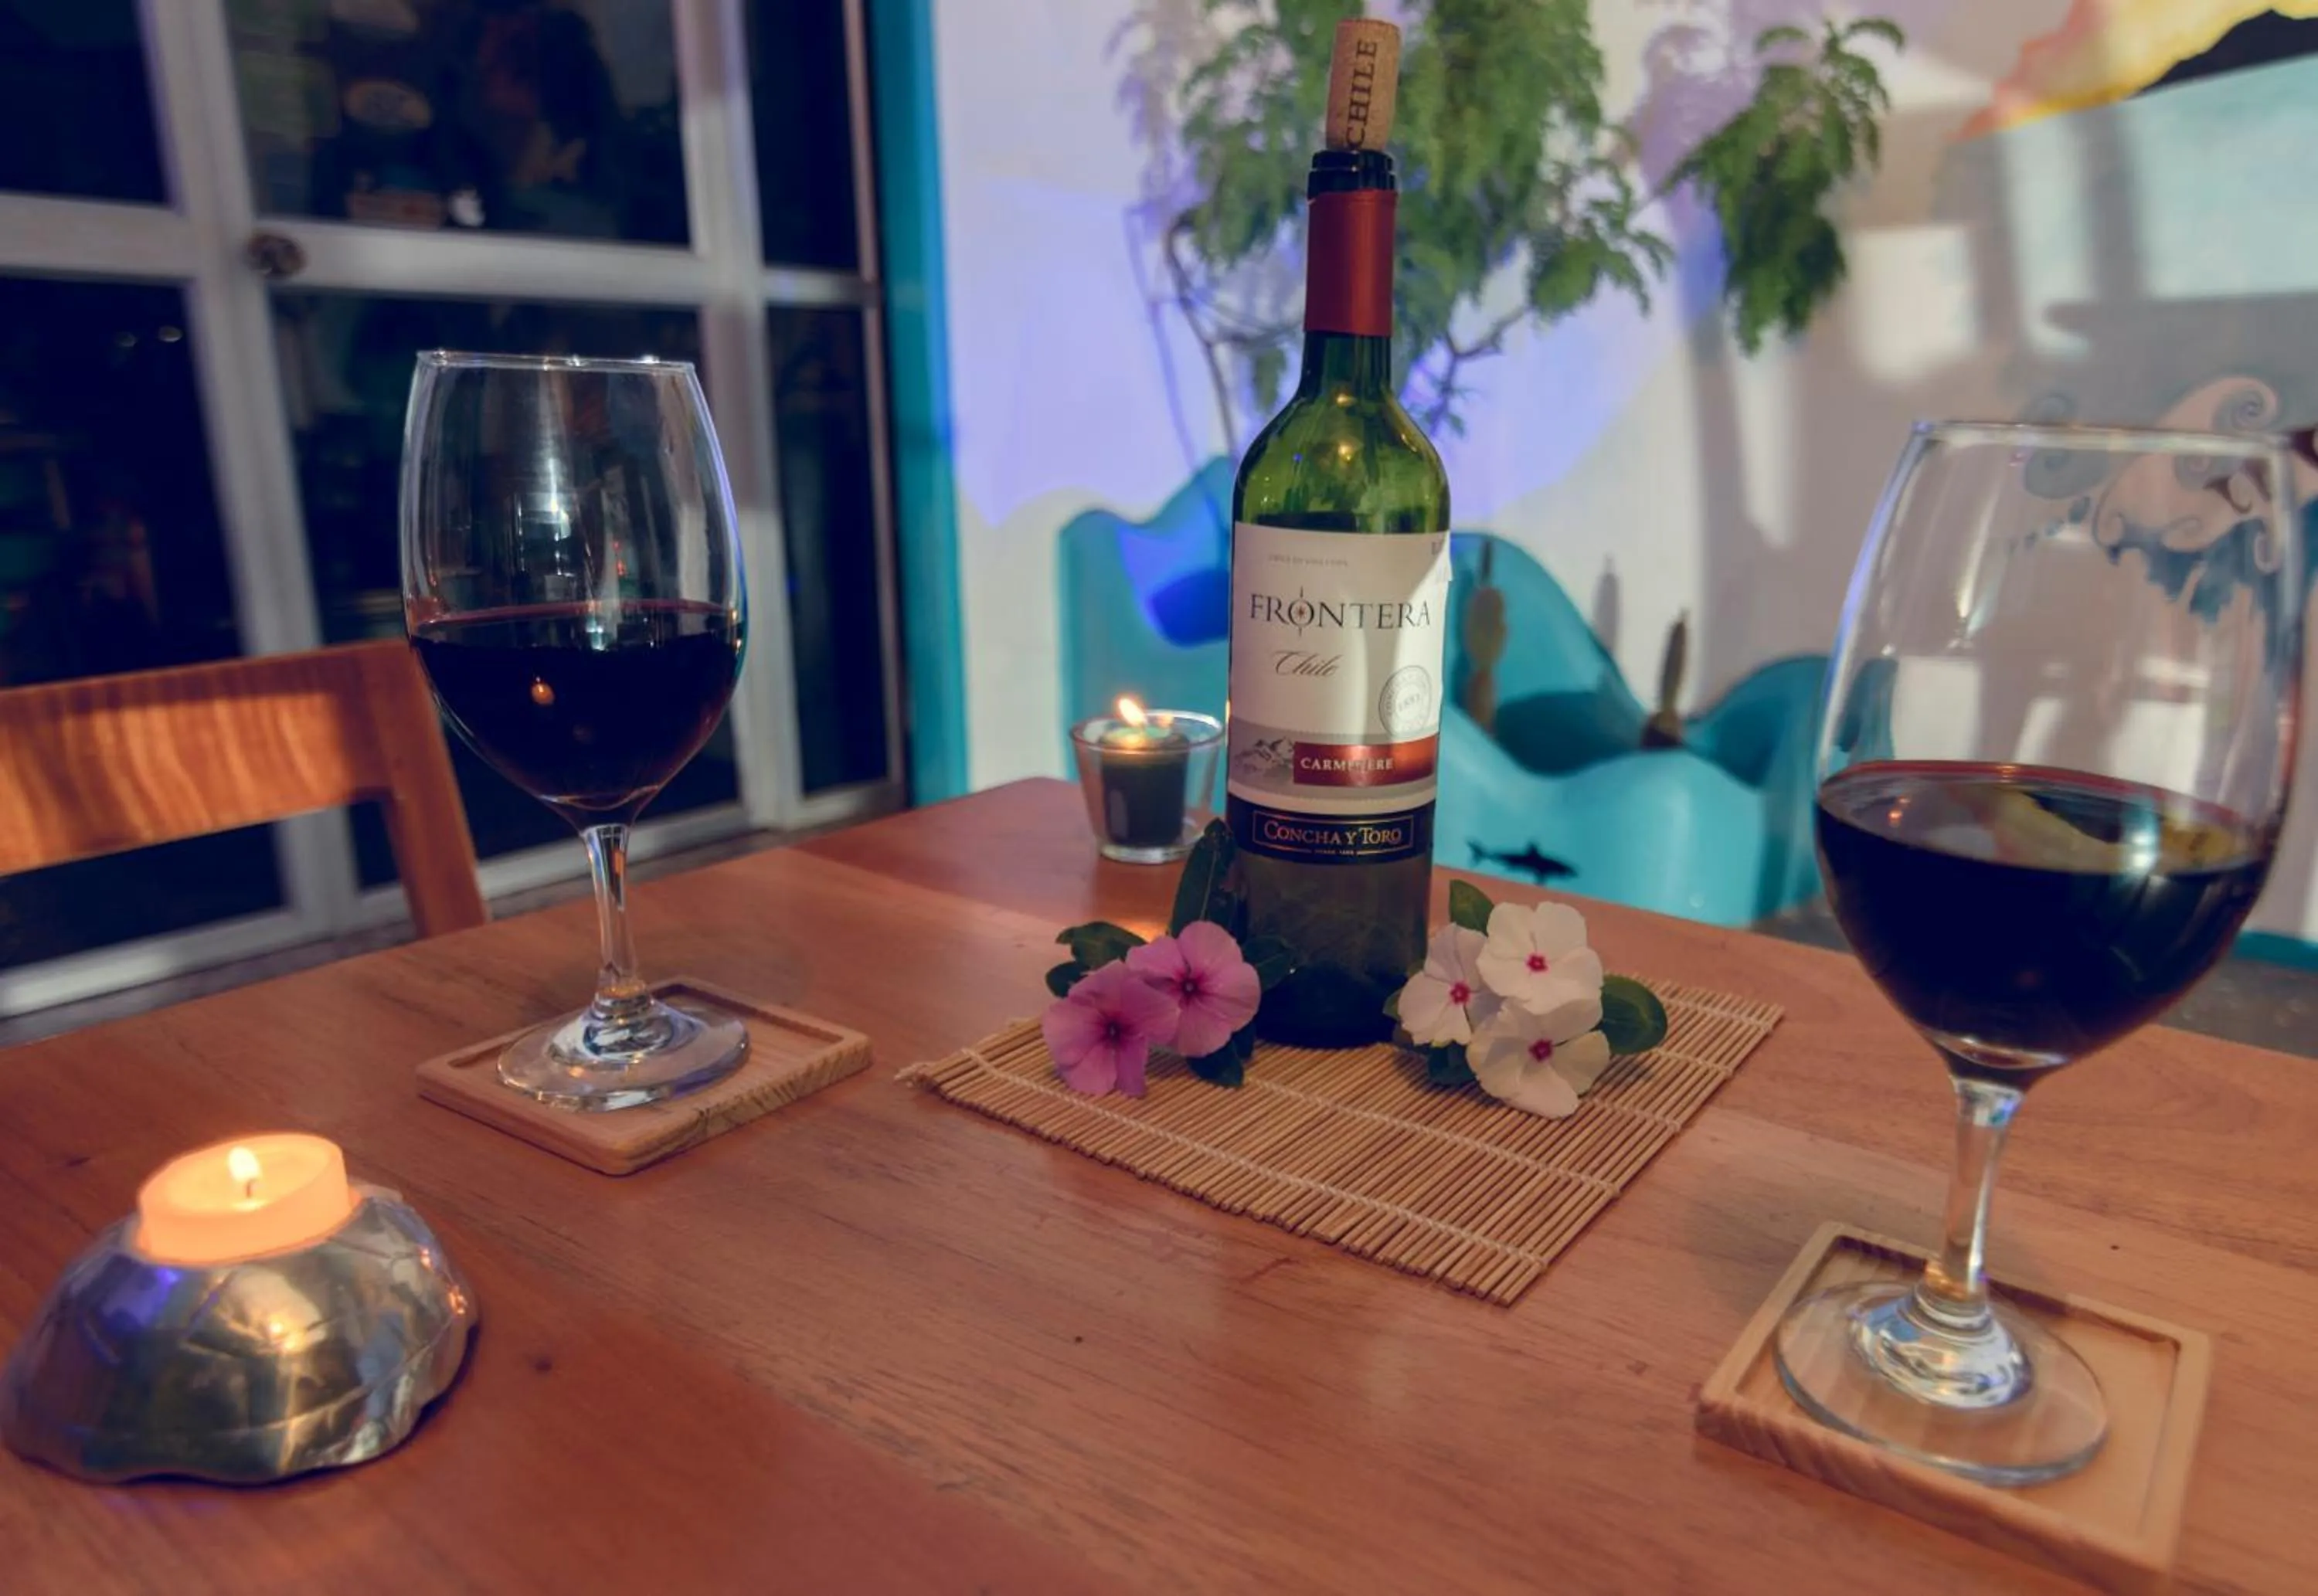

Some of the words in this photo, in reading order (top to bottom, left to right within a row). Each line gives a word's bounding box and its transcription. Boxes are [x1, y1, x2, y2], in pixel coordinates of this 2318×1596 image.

[1346, 39, 1377, 149] CHILE
[1249, 590, 1431, 632] FRONTERA
[1271, 650, 1343, 677] Chile
[1344, 831, 1357, 846] Y
[1360, 827, 1402, 845] TORO
